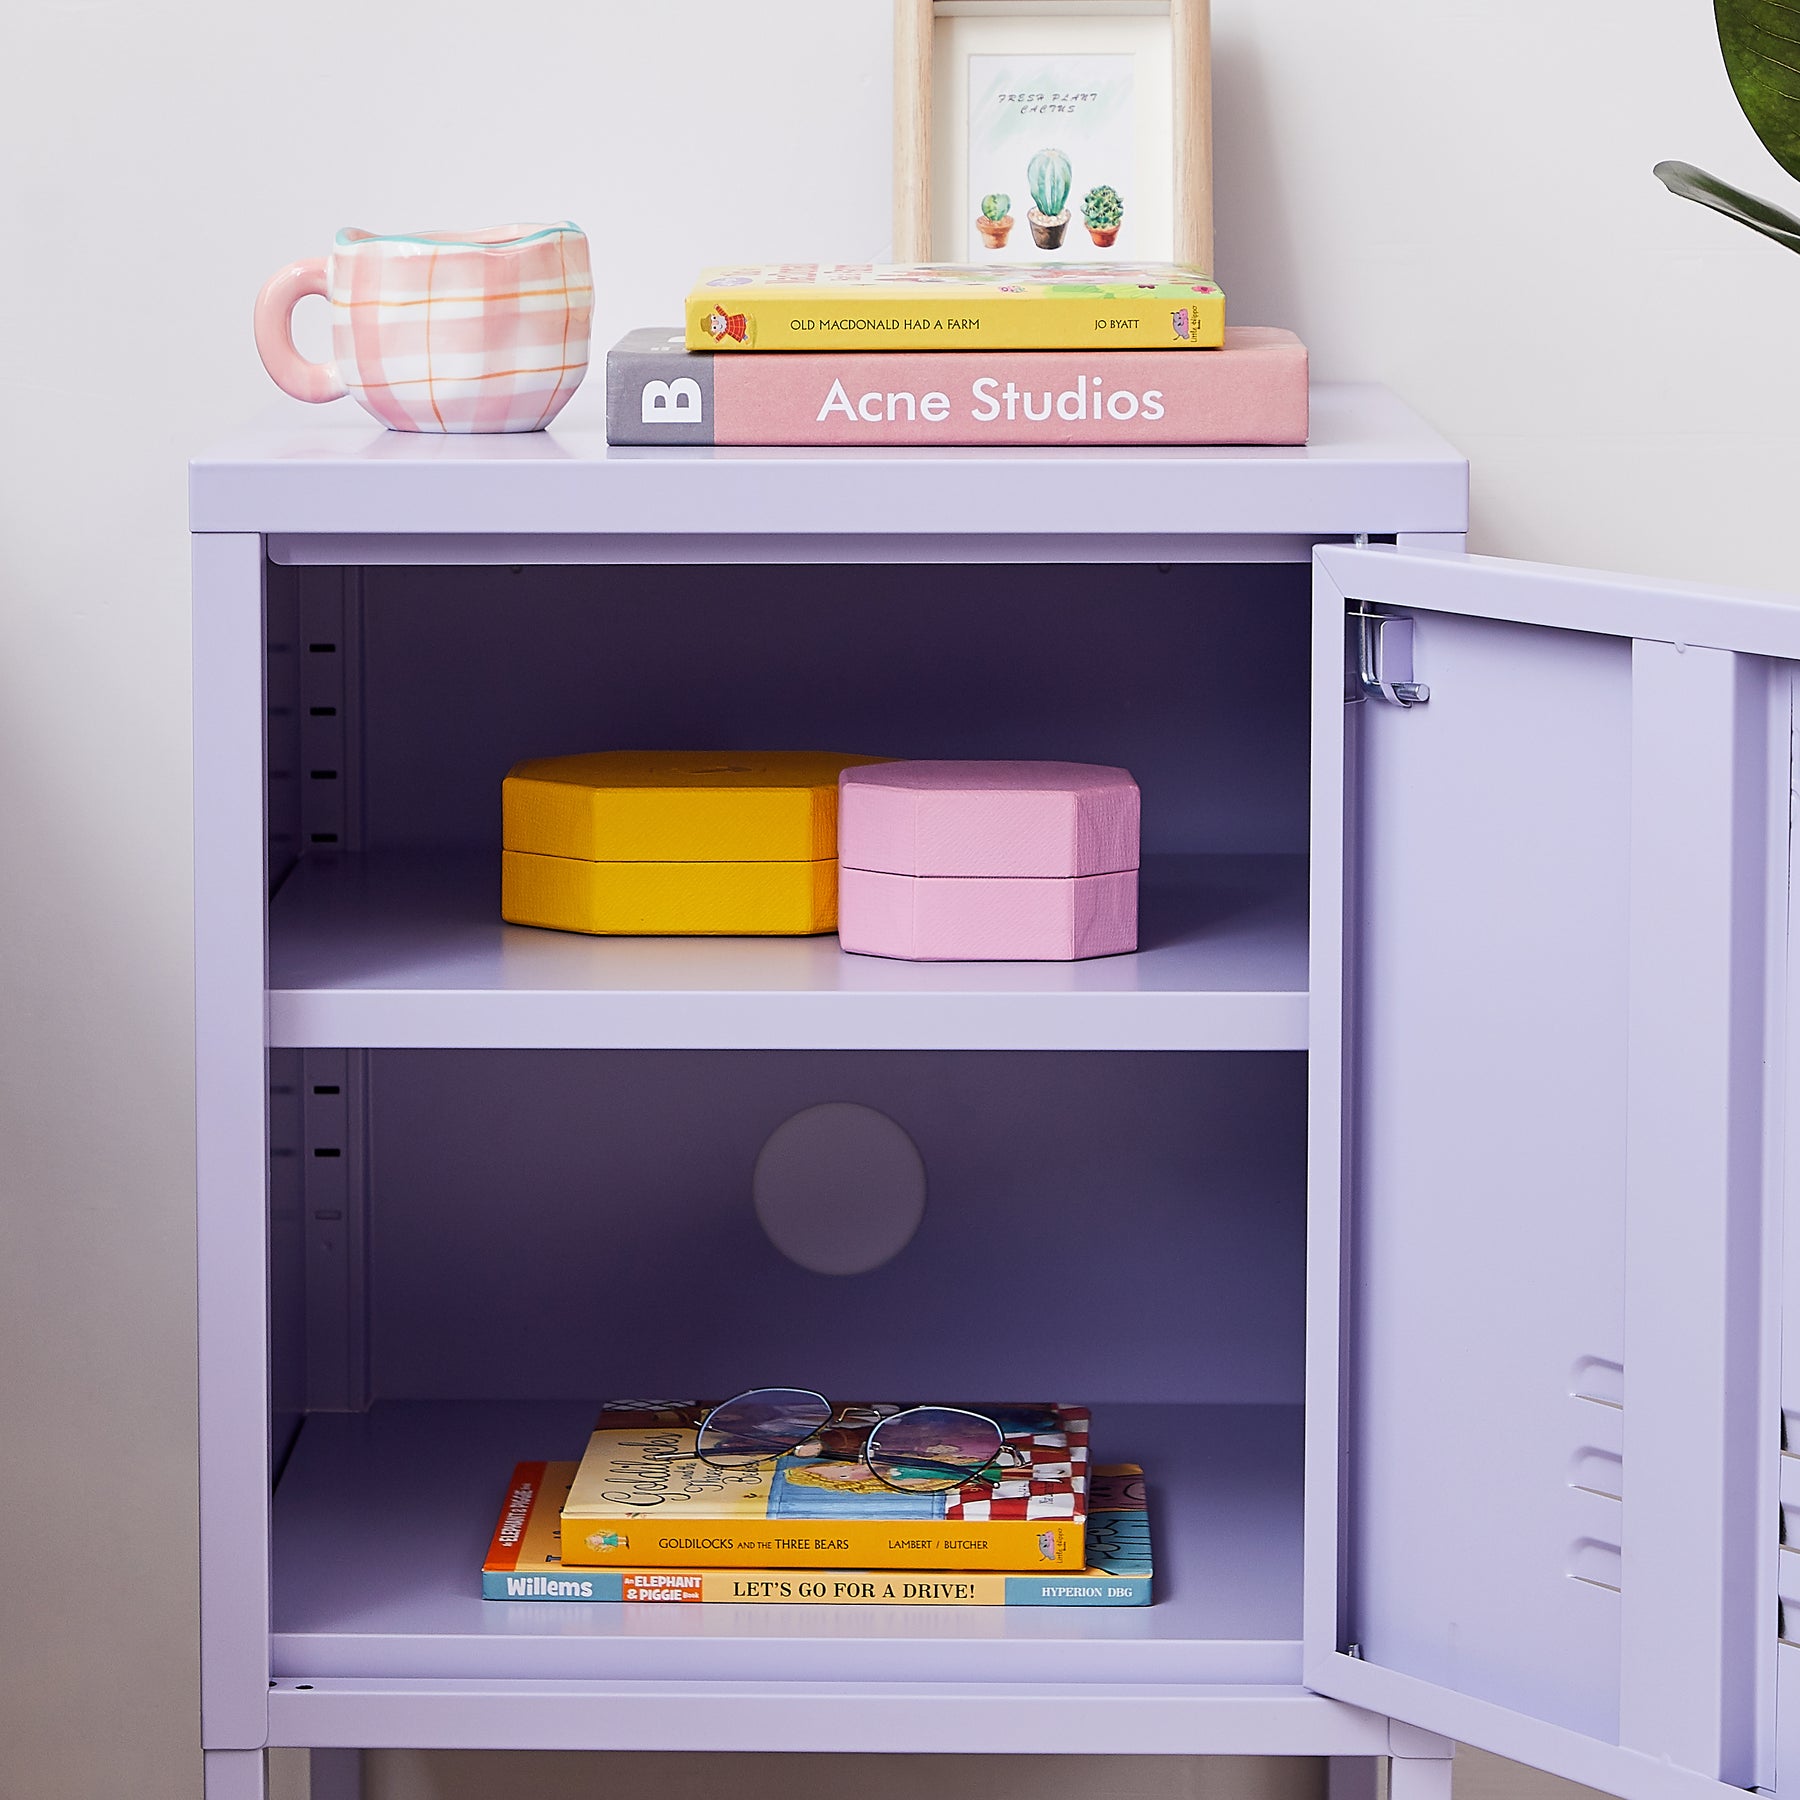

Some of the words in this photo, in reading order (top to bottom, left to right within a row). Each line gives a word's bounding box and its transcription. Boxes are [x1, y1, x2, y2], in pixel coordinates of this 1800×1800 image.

[998, 93, 1045, 102] FRESH
[1052, 93, 1098, 102] PLANT
[1020, 104, 1076, 114] CACTUS
[790, 319, 815, 331] OLD
[819, 319, 900, 331] MACDONALD
[904, 319, 931, 330] HAD
[933, 319, 943, 330] A
[947, 318, 980, 330] FARM
[1094, 319, 1107, 331] JO
[1110, 319, 1140, 330] BYATT
[641, 377, 702, 423] B
[816, 377, 951, 422] Acne
[971, 375, 1165, 422] Studios
[658, 1538, 734, 1549] GOLDILOCKS
[737, 1541, 756, 1549] AND
[757, 1541, 772, 1549] THE
[774, 1538, 810, 1550] THREE
[814, 1539, 850, 1550] BEARS
[888, 1539, 933, 1549] LAMBERT
[944, 1539, 988, 1550] BUTCHER
[506, 1576, 593, 1597] Willems
[624, 1577, 635, 1585] An
[634, 1575, 702, 1588] ELEPHANT
[626, 1588, 638, 1600] &
[639, 1588, 683, 1601] PIGGIE
[732, 1581, 792, 1598] LET'S
[798, 1582, 827, 1598] GO
[833, 1582, 876, 1599] FOR
[882, 1583, 896, 1599] A
[903, 1583, 976, 1599] DRIVE!
[1041, 1587, 1103, 1598] HYPERION
[1107, 1587, 1133, 1598] DBG
